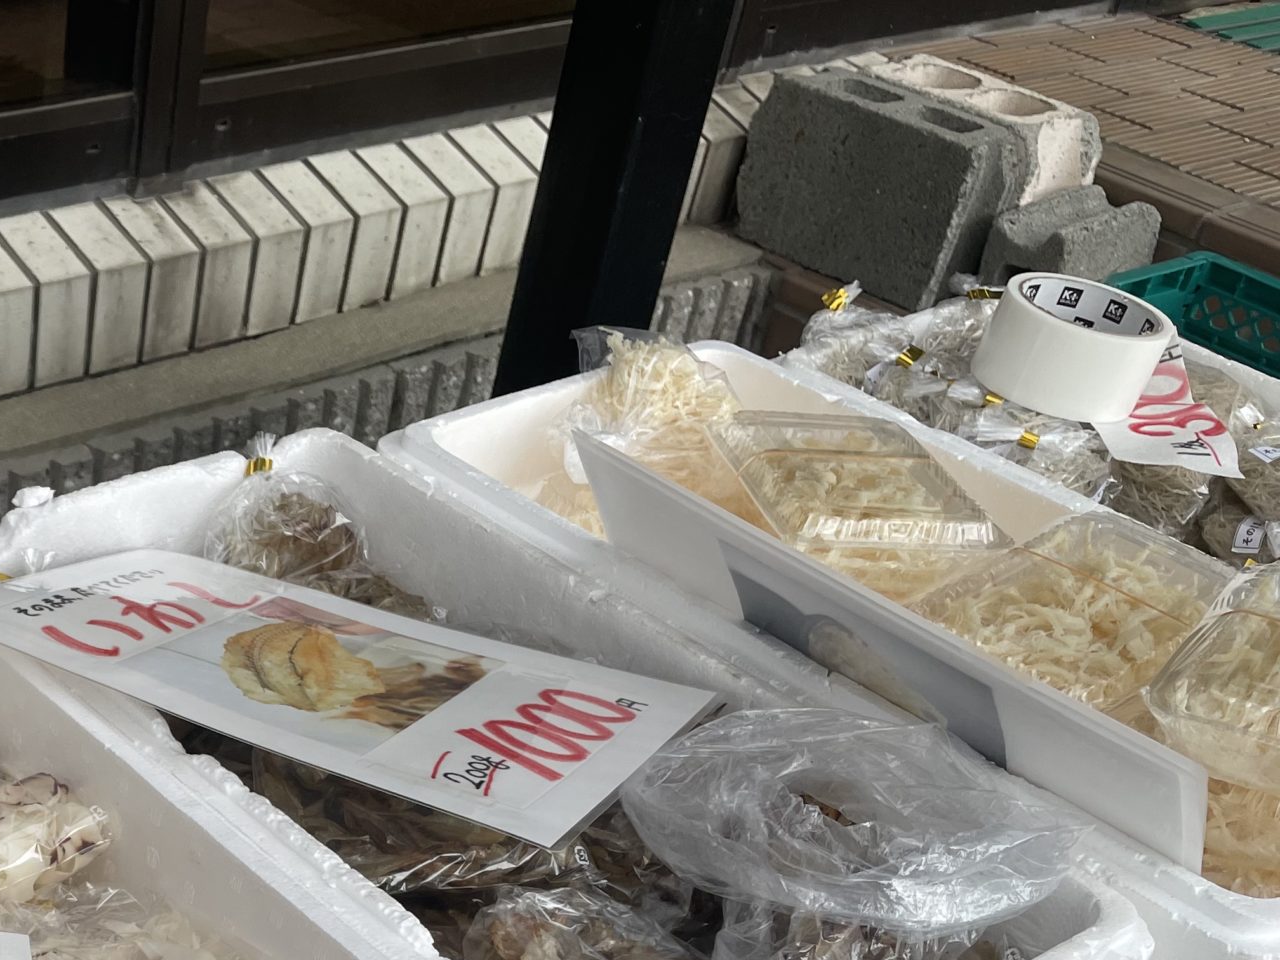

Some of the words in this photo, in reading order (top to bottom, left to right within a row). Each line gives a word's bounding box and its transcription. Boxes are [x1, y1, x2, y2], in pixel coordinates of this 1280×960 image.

[41, 582, 261, 657] いわし
[443, 755, 510, 790] 200g
